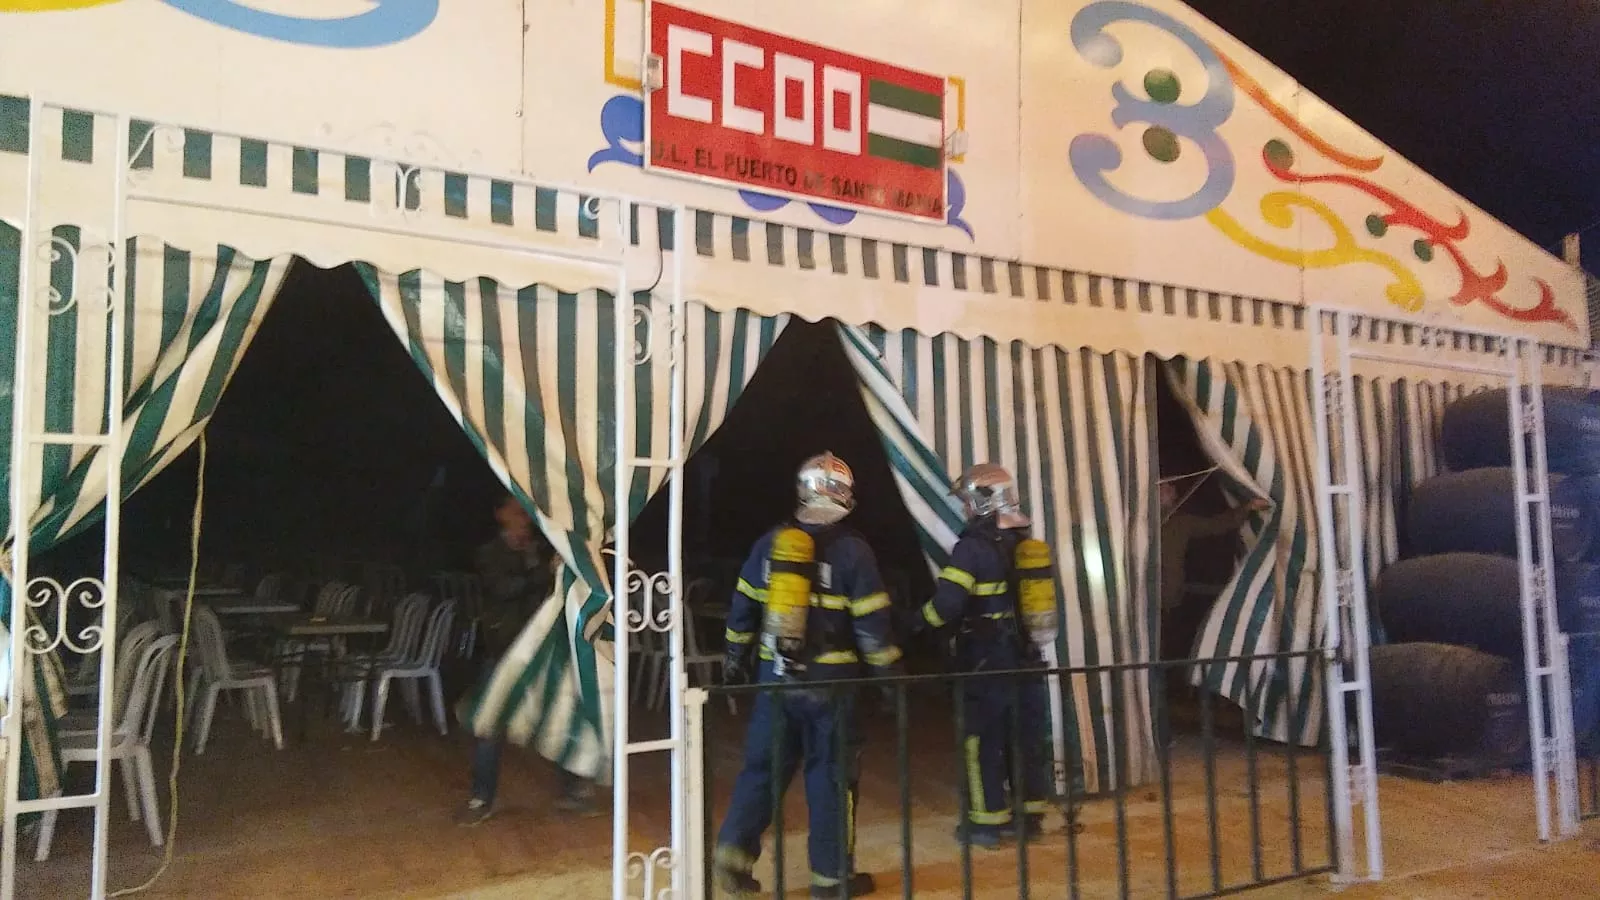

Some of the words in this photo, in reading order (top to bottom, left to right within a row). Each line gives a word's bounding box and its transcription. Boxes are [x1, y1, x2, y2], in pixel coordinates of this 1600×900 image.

[667, 23, 862, 156] CCOO
[695, 147, 716, 170] EL
[724, 150, 797, 186] PUERTO
